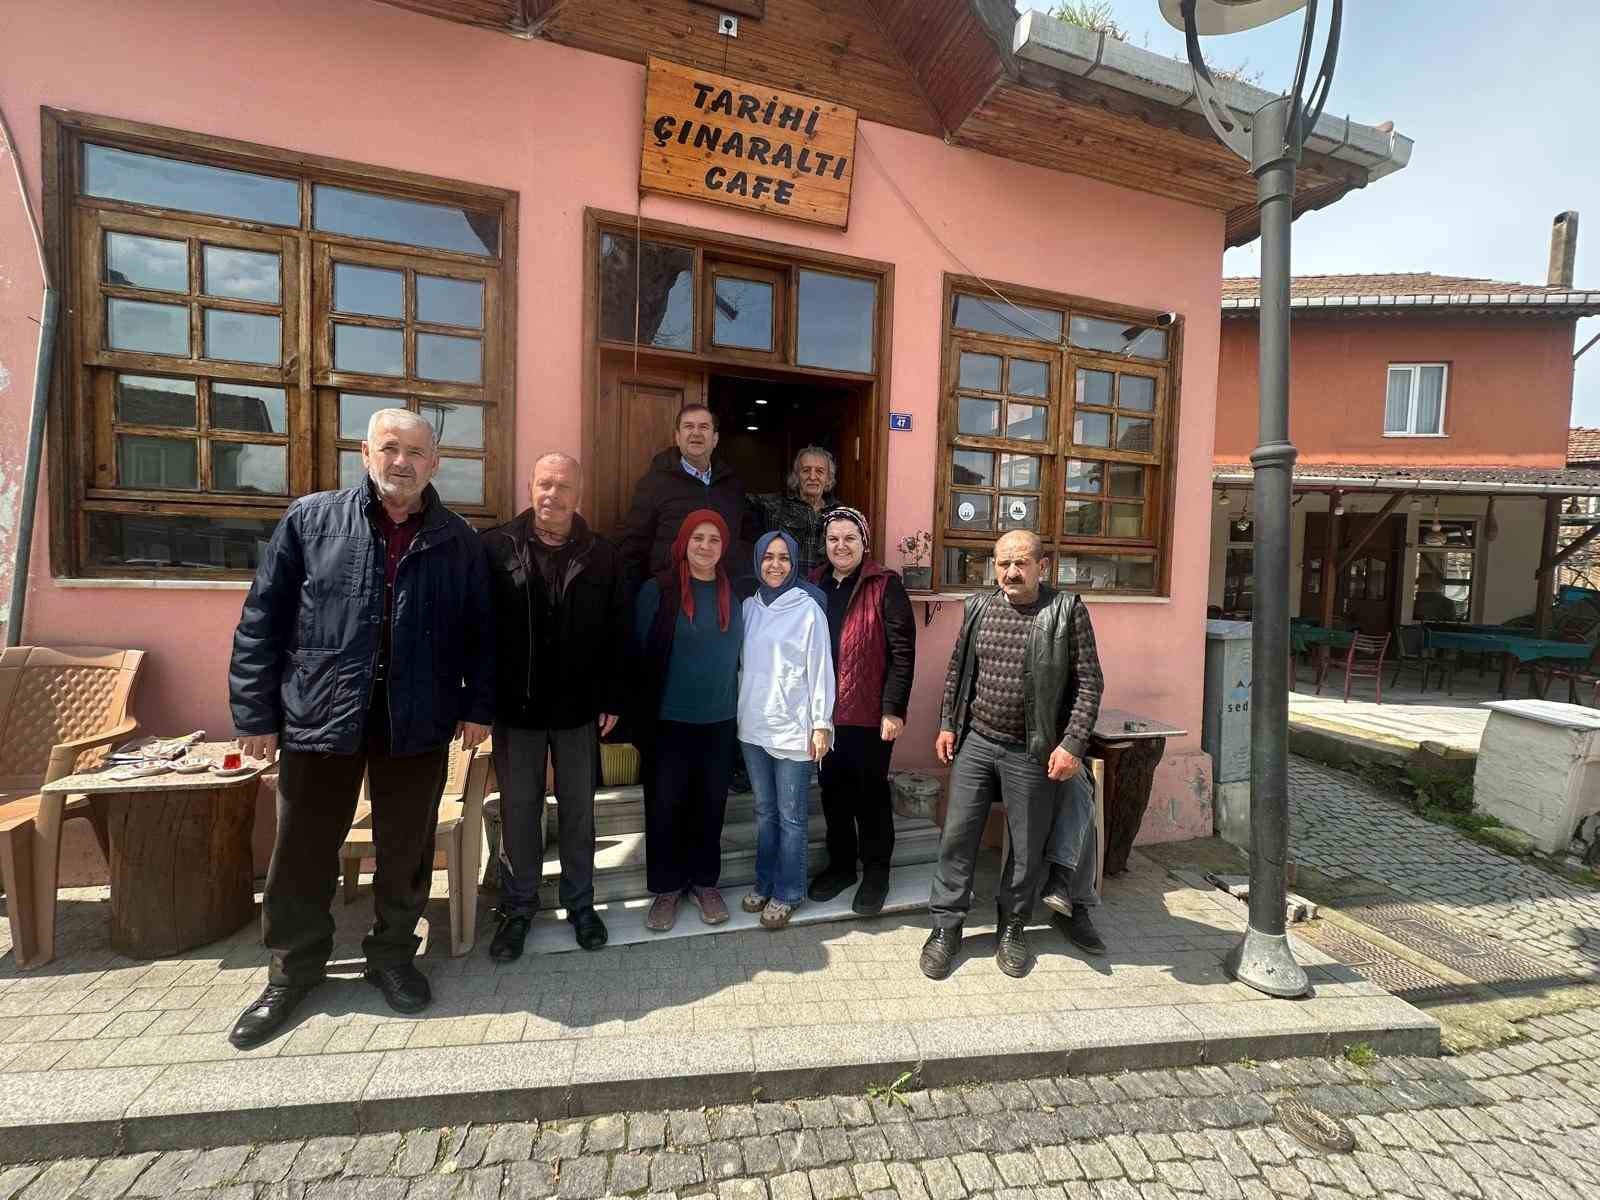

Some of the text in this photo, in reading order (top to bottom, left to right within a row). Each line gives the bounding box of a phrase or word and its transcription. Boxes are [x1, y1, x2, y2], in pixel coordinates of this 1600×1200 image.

[693, 83, 820, 135] TARİHİ
[653, 116, 847, 180] ÇINARALTI
[705, 166, 795, 205] CAFE
[896, 418, 906, 428] 47
[1227, 701, 1249, 713] sed
